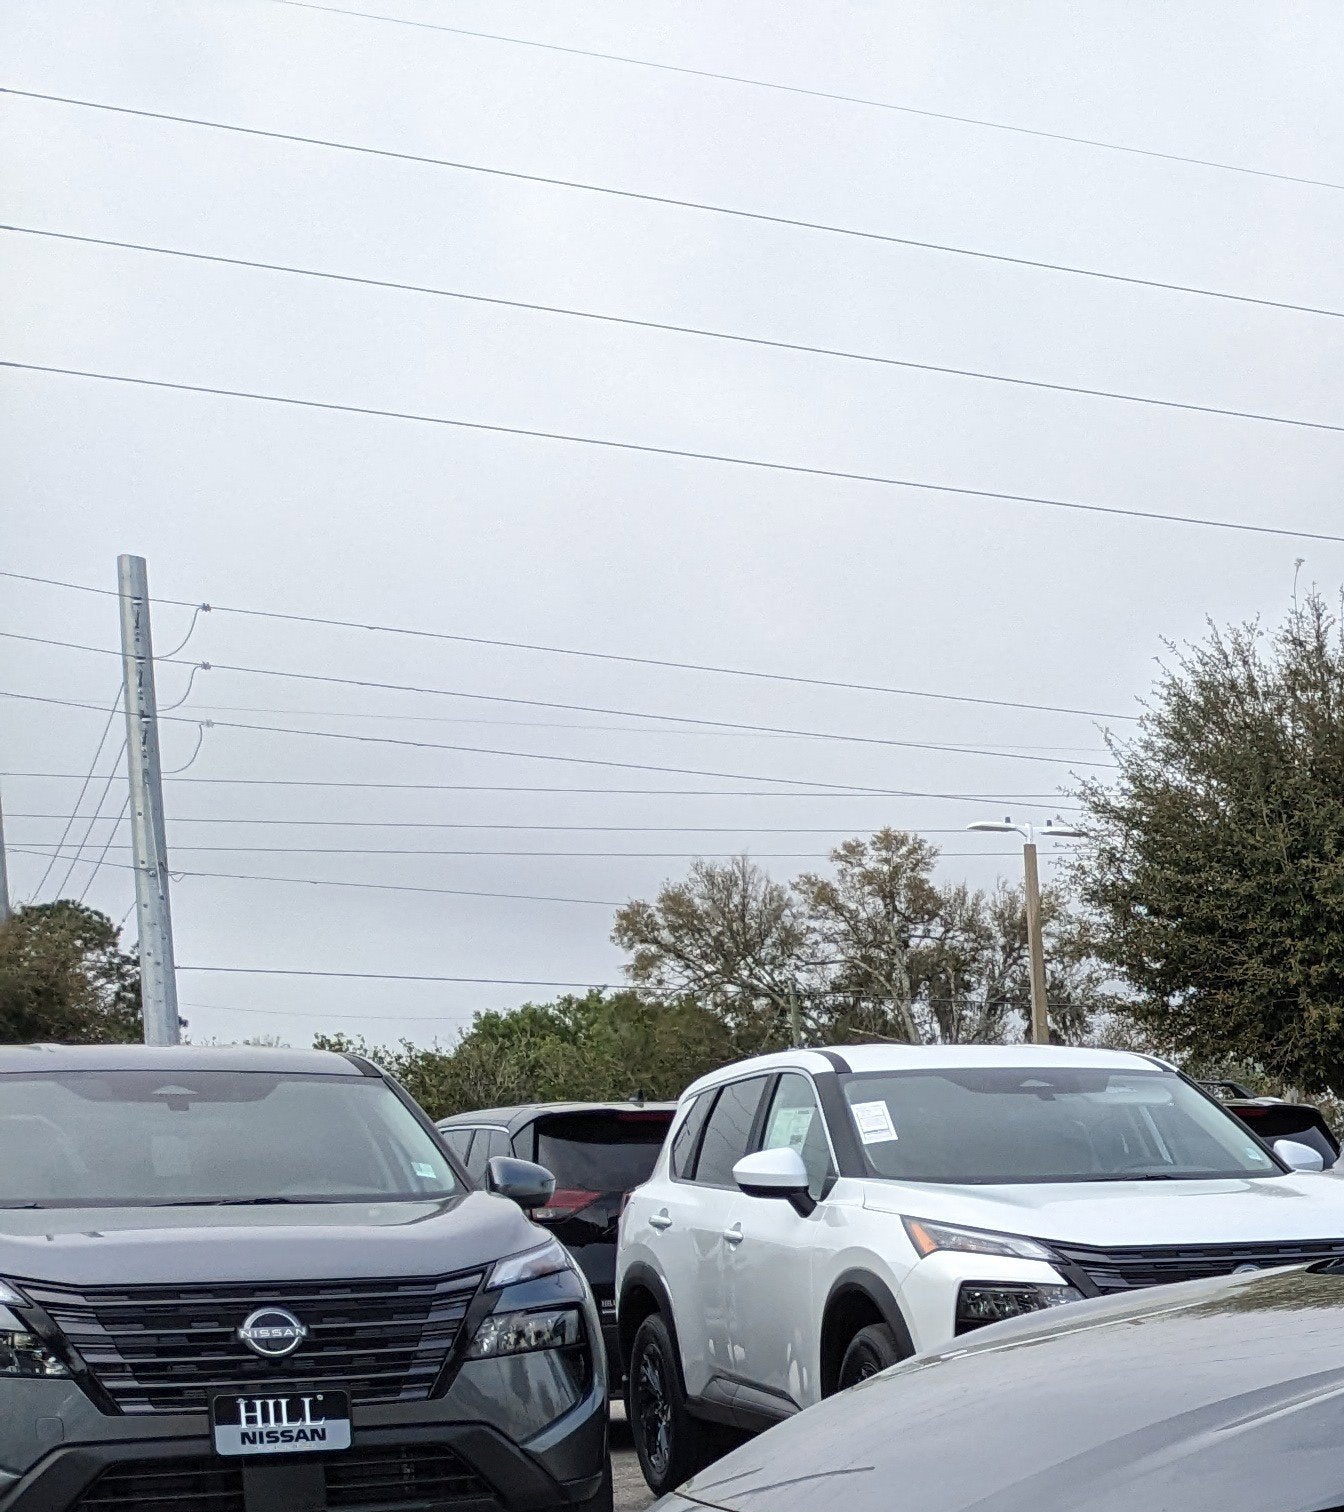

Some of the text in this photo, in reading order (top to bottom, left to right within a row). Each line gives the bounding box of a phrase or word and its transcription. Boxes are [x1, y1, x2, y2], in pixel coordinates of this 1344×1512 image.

[239, 1328, 308, 1339] NISSAN
[238, 1396, 325, 1428] HILL
[240, 1427, 327, 1445] NISSAN
